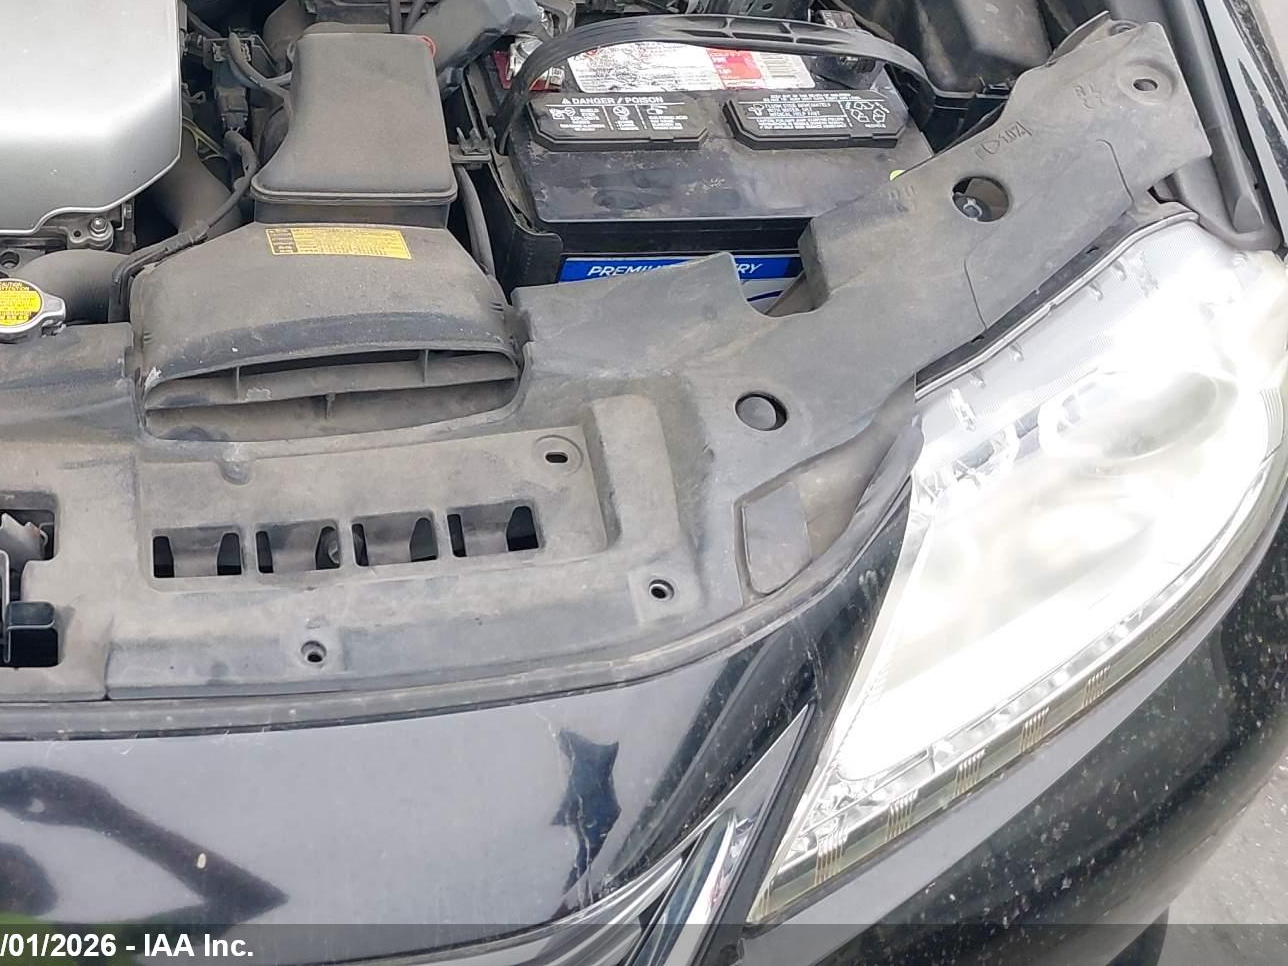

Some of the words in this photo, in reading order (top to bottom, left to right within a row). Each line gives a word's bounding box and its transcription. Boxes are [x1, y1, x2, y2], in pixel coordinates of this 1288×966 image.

[571, 97, 616, 105] DANGER
[624, 96, 664, 104] POISON
[587, 265, 661, 276] PREMI
